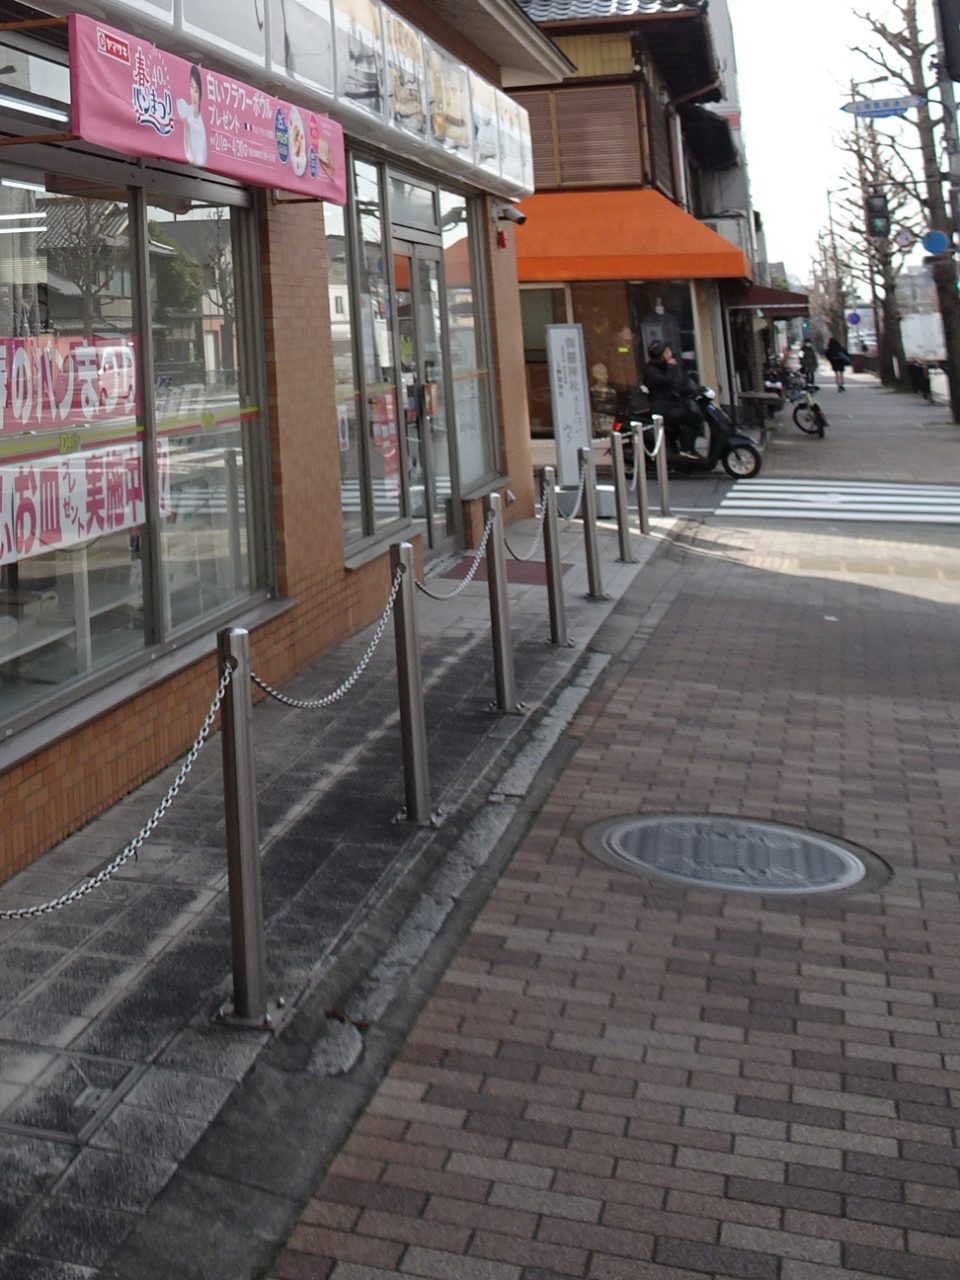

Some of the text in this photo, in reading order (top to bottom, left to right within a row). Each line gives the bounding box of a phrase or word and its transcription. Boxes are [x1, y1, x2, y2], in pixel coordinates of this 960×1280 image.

[106, 35, 129, 58] ヤマザキ
[208, 105, 240, 134] プレゼント
